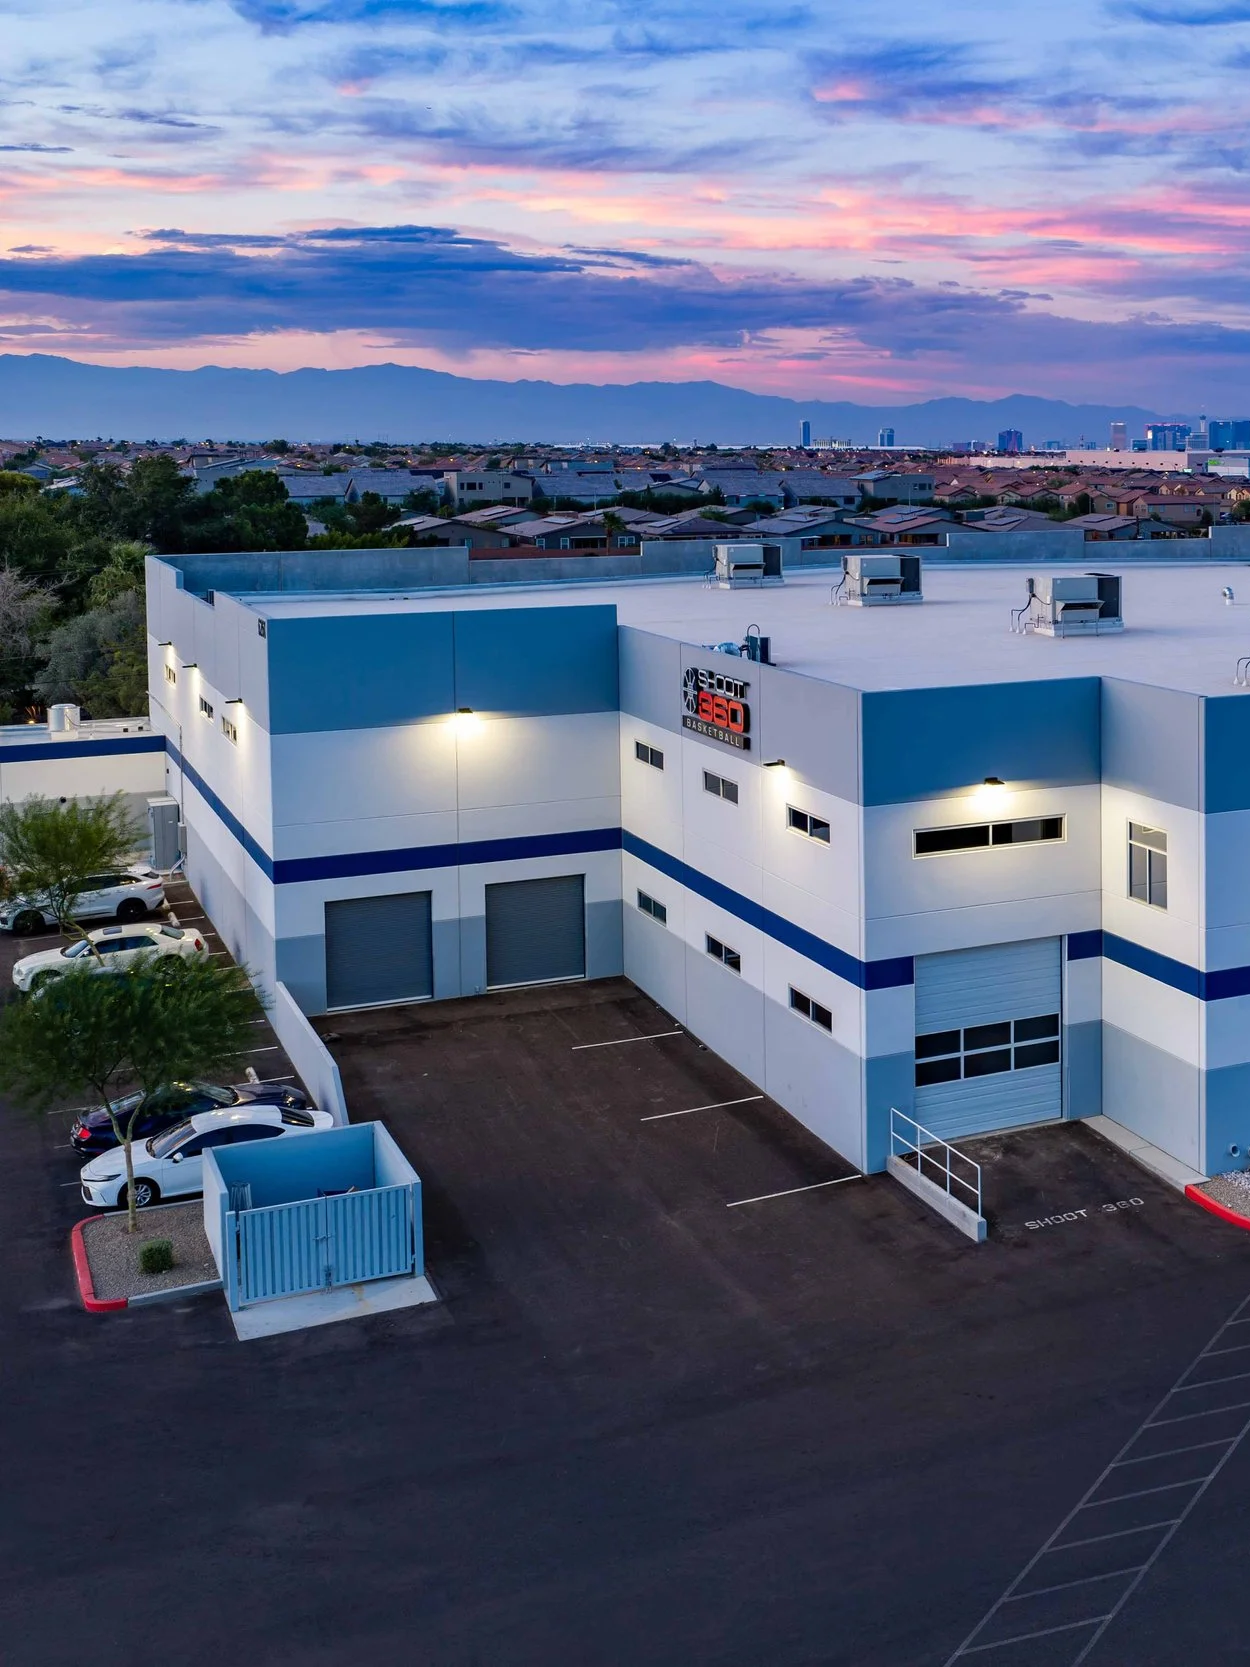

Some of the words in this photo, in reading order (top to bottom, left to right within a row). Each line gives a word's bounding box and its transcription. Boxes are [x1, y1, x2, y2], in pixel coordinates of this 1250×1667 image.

[698, 670, 744, 698] SHOOT
[698, 691, 744, 733] 360
[686, 718, 740, 747] BASKETBALL
[1024, 1209, 1088, 1230] SHOOT
